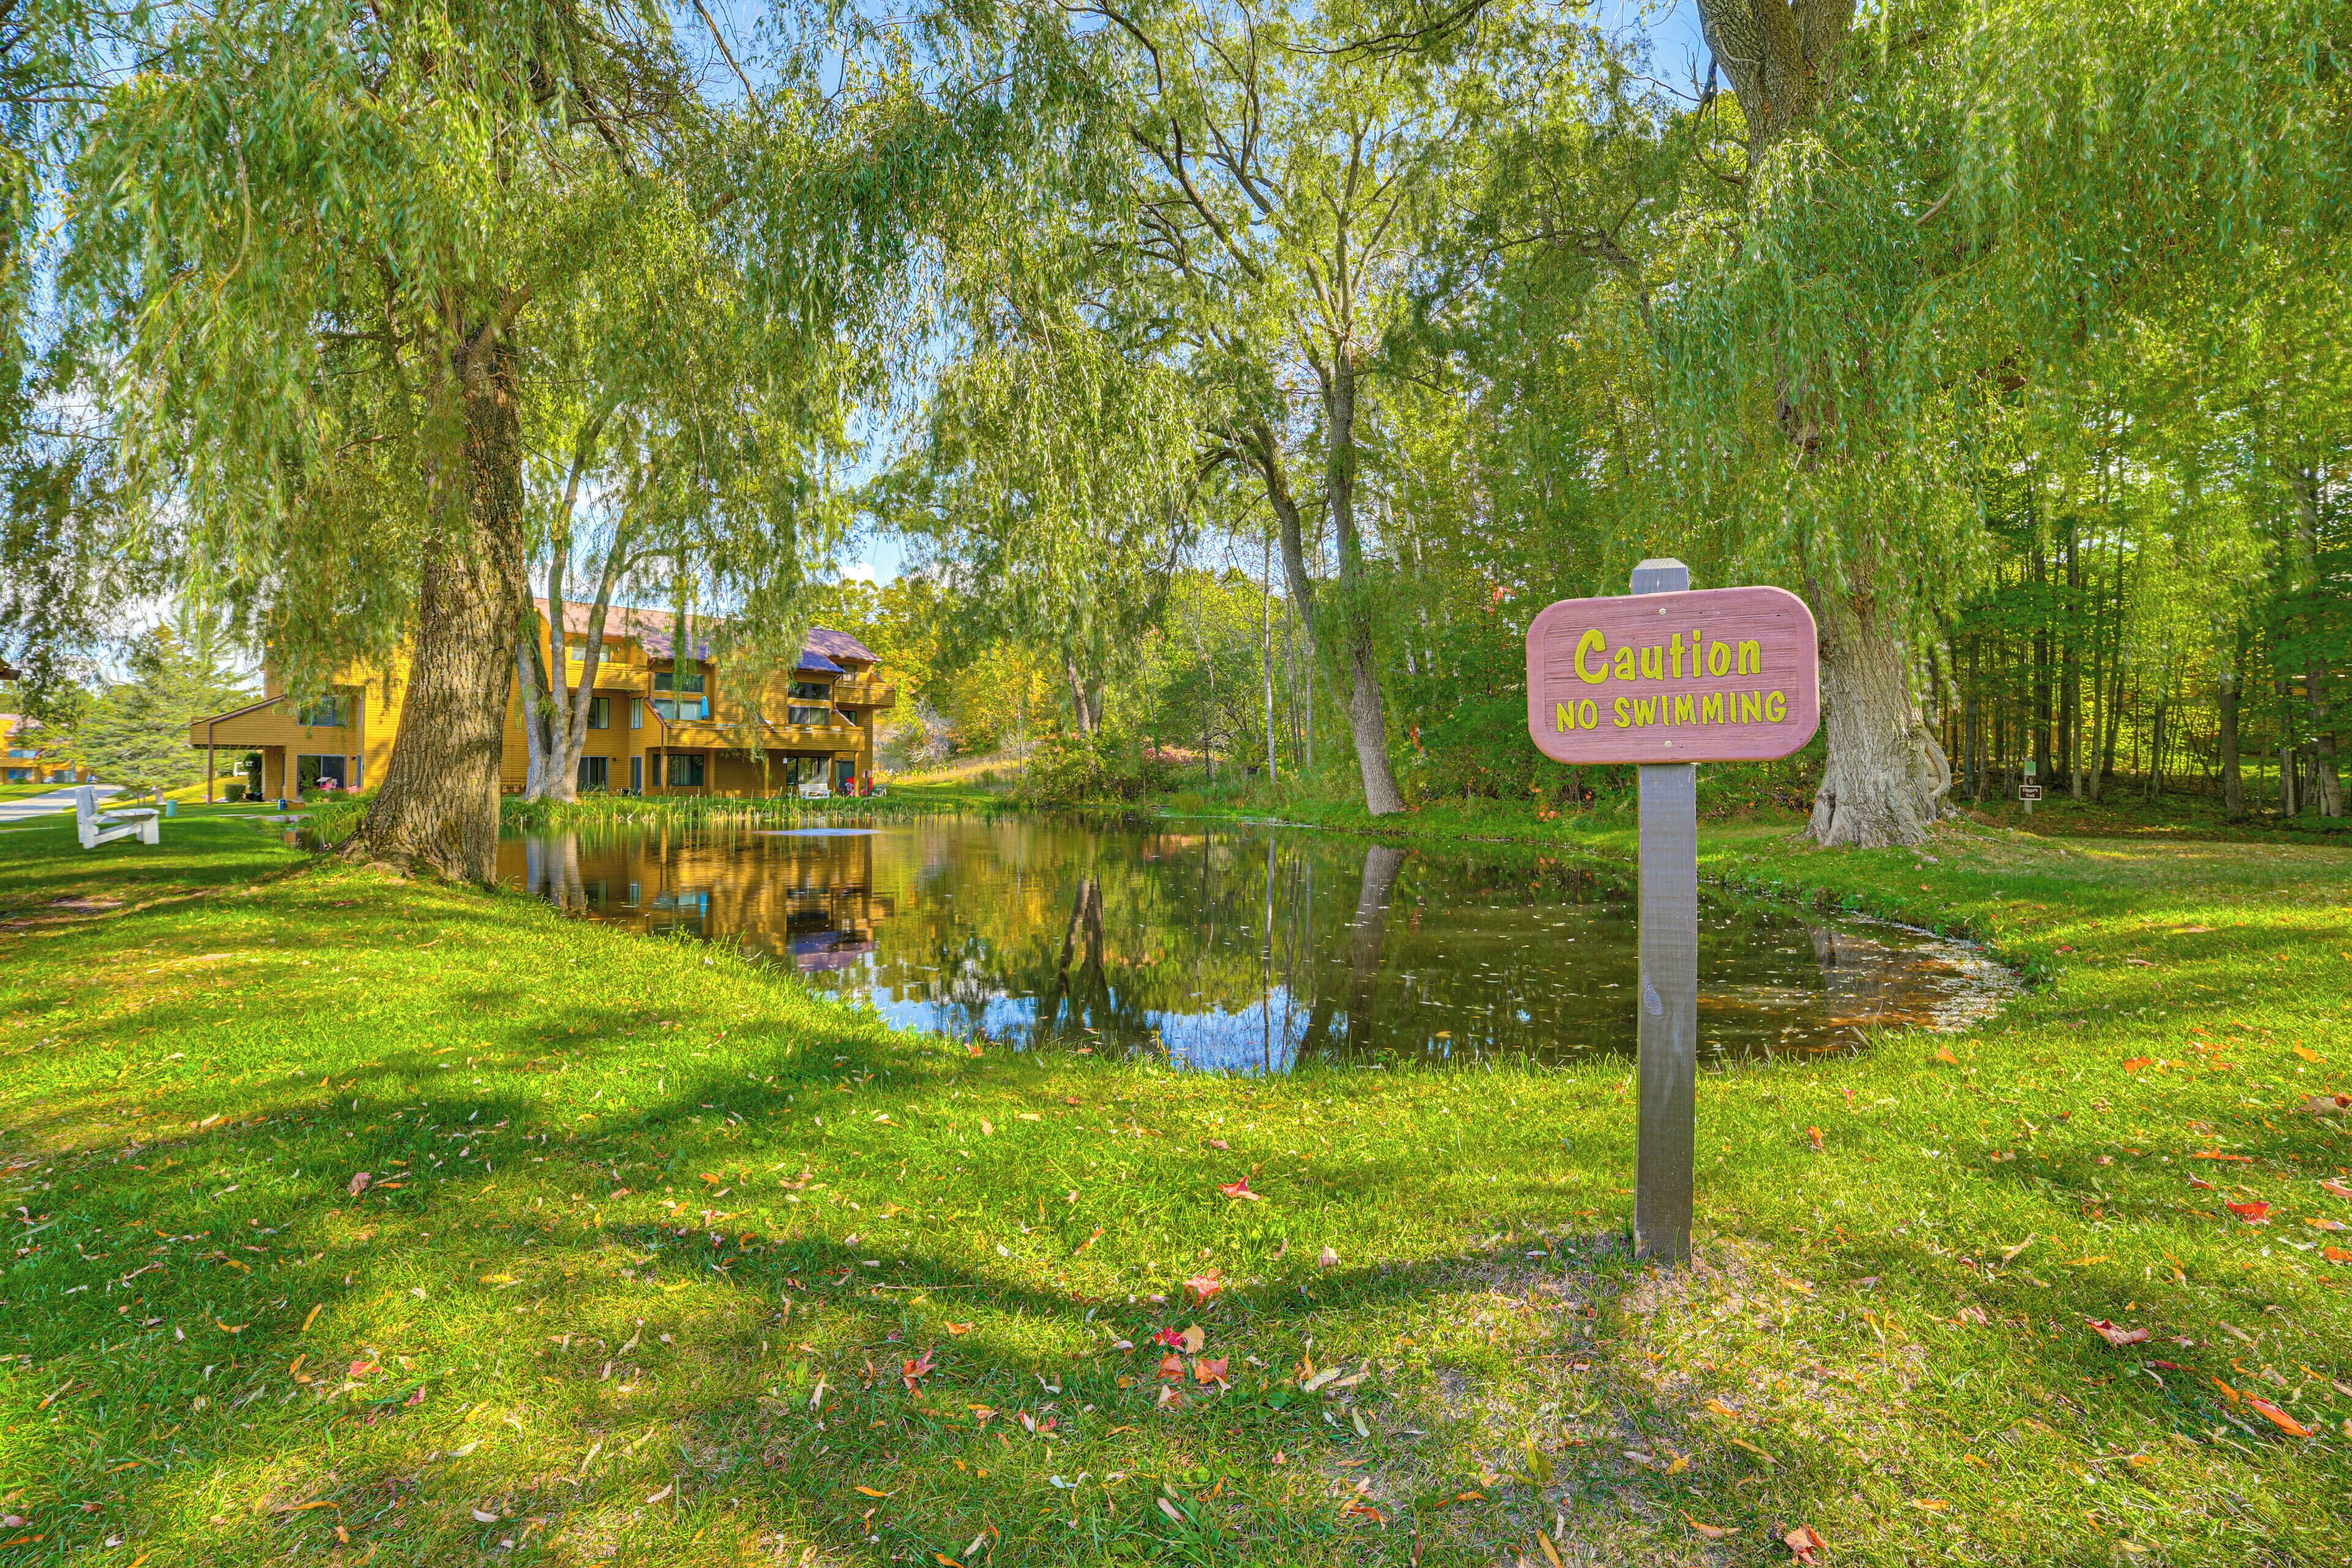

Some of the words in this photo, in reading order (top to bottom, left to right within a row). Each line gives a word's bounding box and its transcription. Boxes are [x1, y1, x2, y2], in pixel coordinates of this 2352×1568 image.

[1574, 629, 1761, 684] Caution
[1556, 699, 1599, 733] NO
[1613, 690, 1788, 728] SWIMMING
